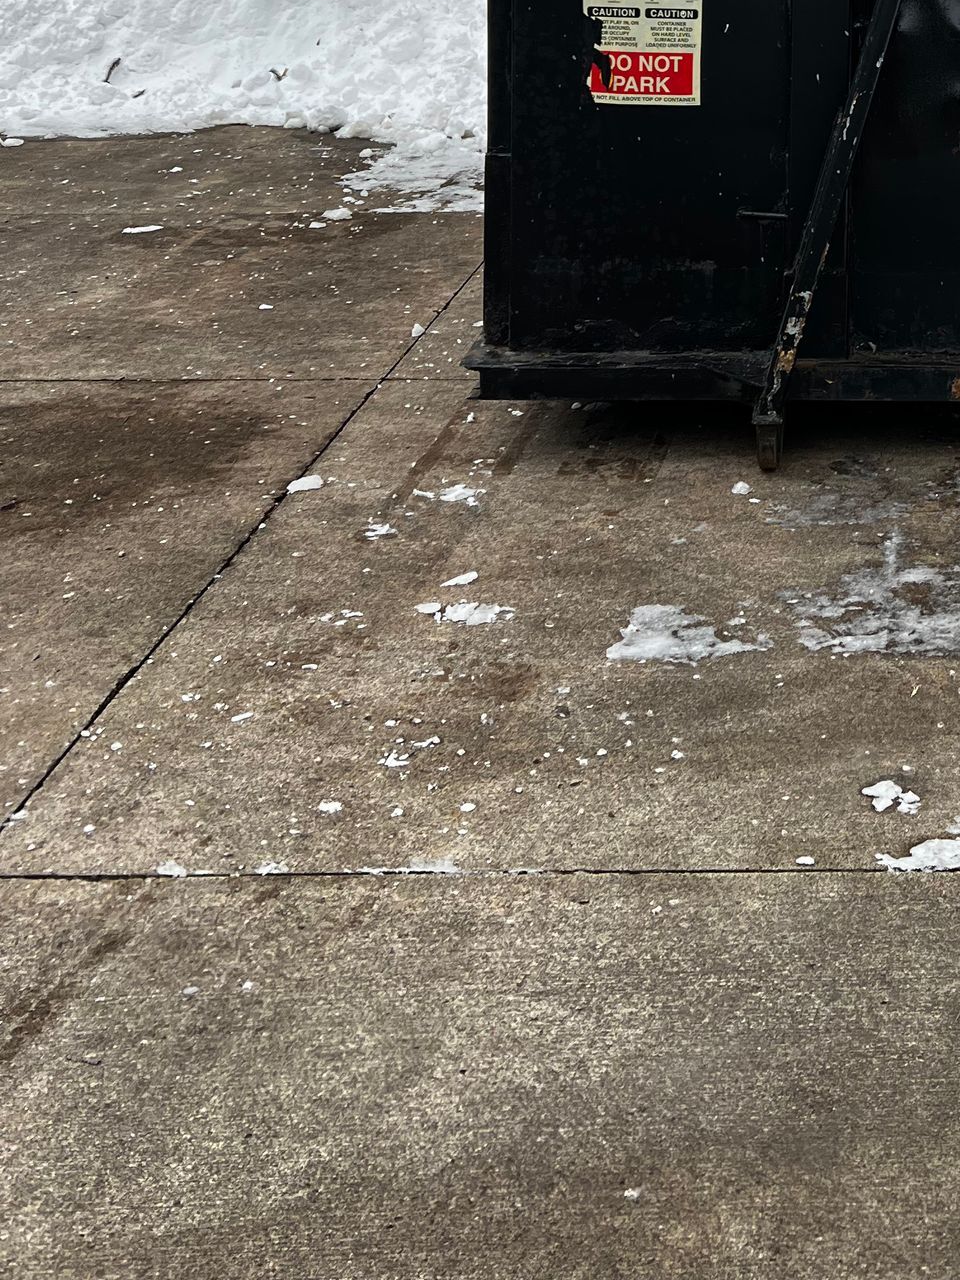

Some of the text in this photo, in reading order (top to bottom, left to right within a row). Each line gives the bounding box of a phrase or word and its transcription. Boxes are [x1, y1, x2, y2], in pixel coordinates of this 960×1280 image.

[592, 8, 635, 16] CAUTION
[650, 10, 693, 18] CAUTION
[639, 56, 683, 72] NOT
[613, 76, 671, 93] PARK
